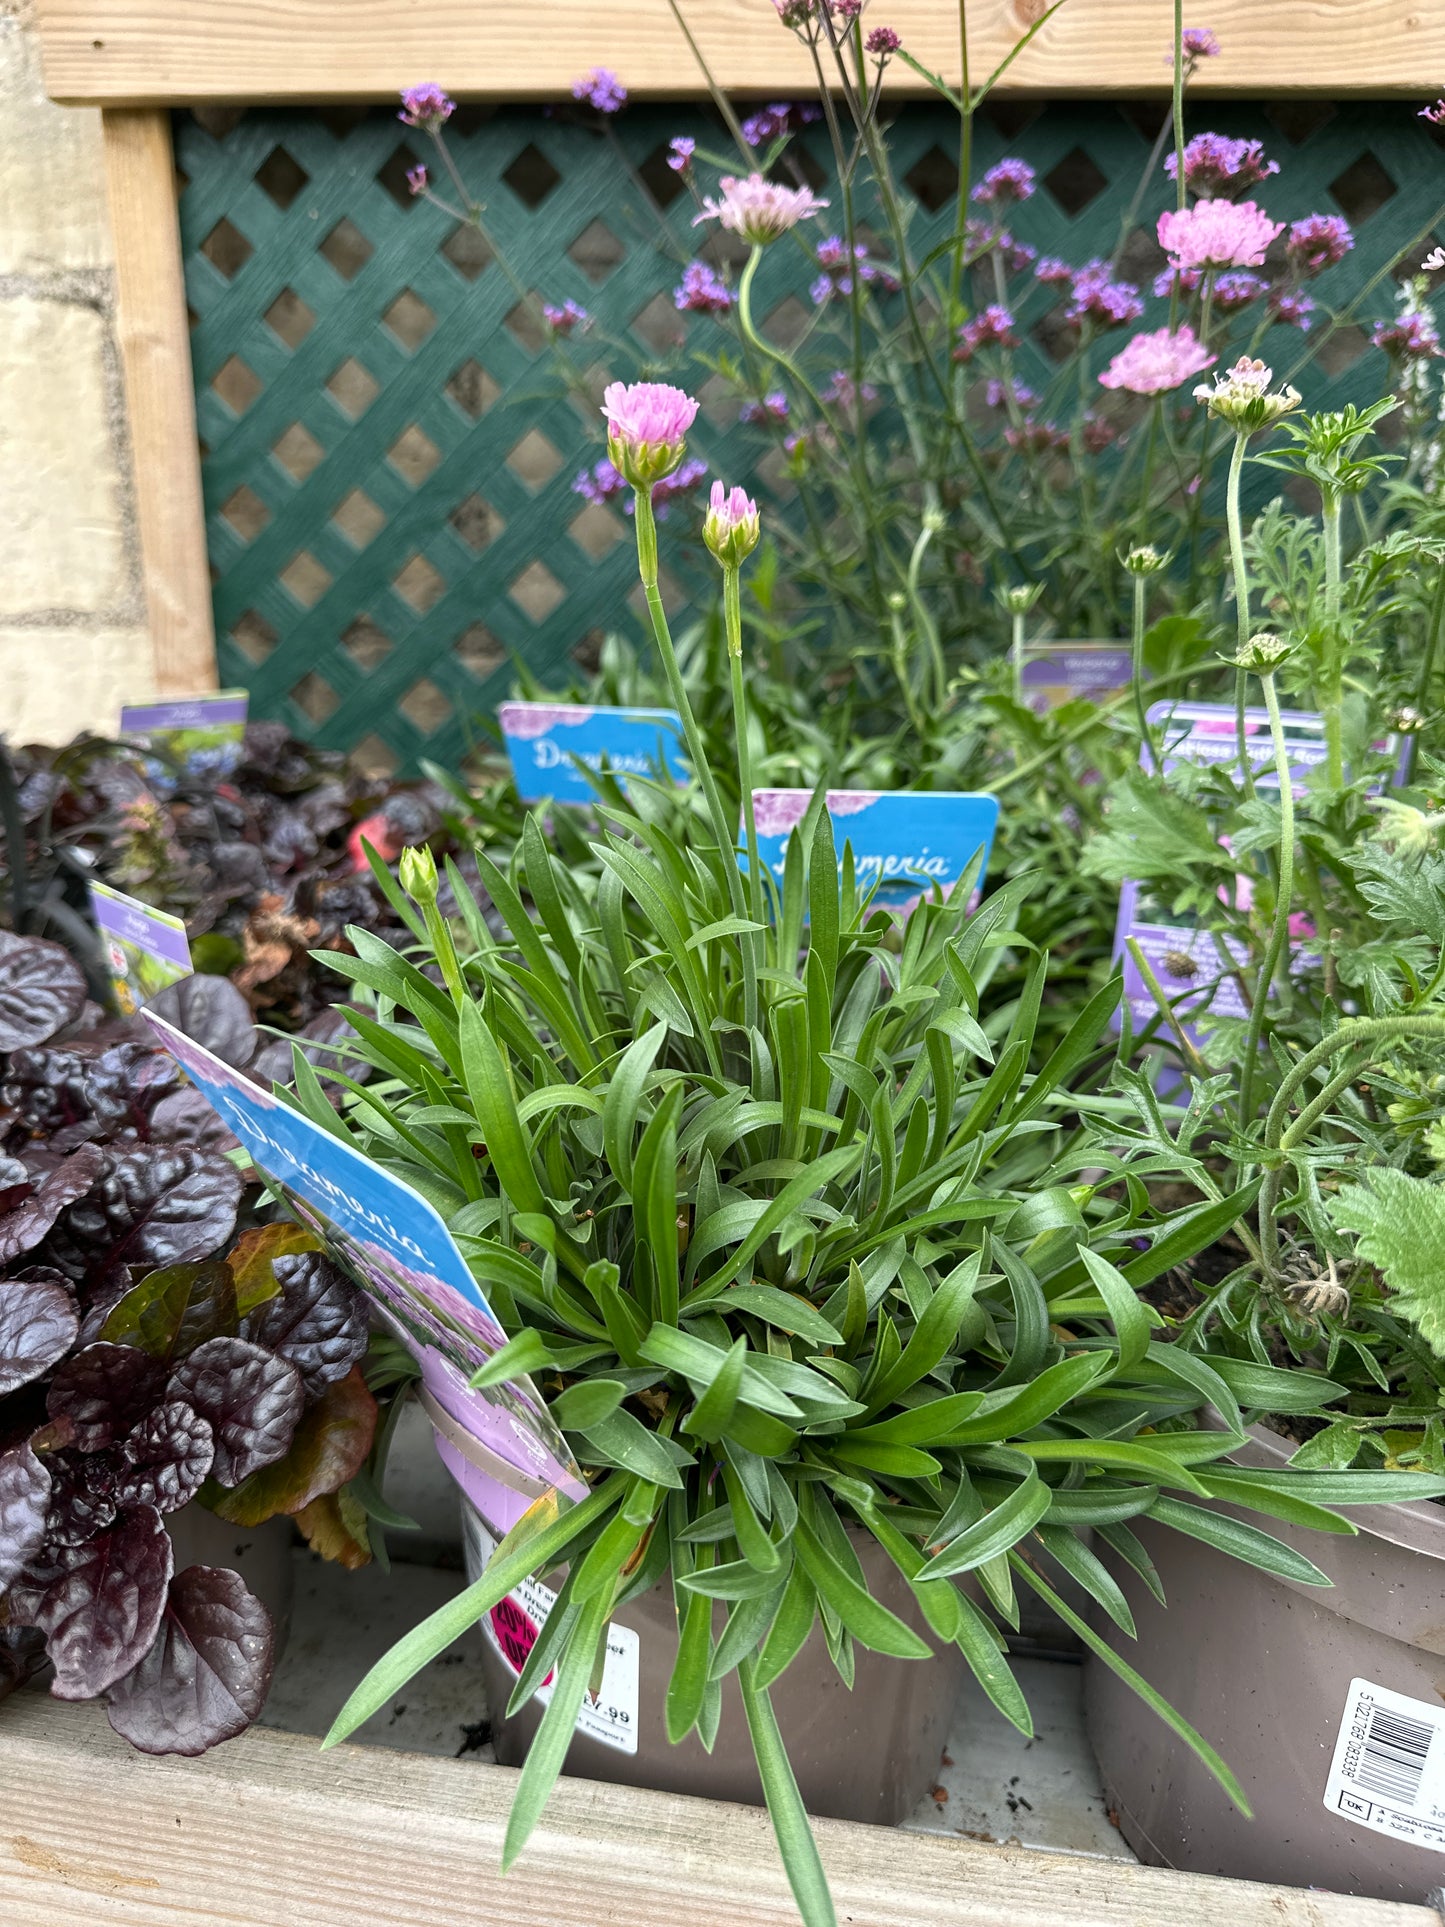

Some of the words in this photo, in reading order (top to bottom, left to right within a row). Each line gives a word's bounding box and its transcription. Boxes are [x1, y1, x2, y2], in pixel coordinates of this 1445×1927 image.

[222, 1095, 436, 1268] Dreameria
[1359, 1691, 1375, 1702] 5
[1351, 1702, 1372, 1741] 021768
[1341, 1741, 1362, 1779] 083338
[1346, 1800, 1364, 1812] UK
